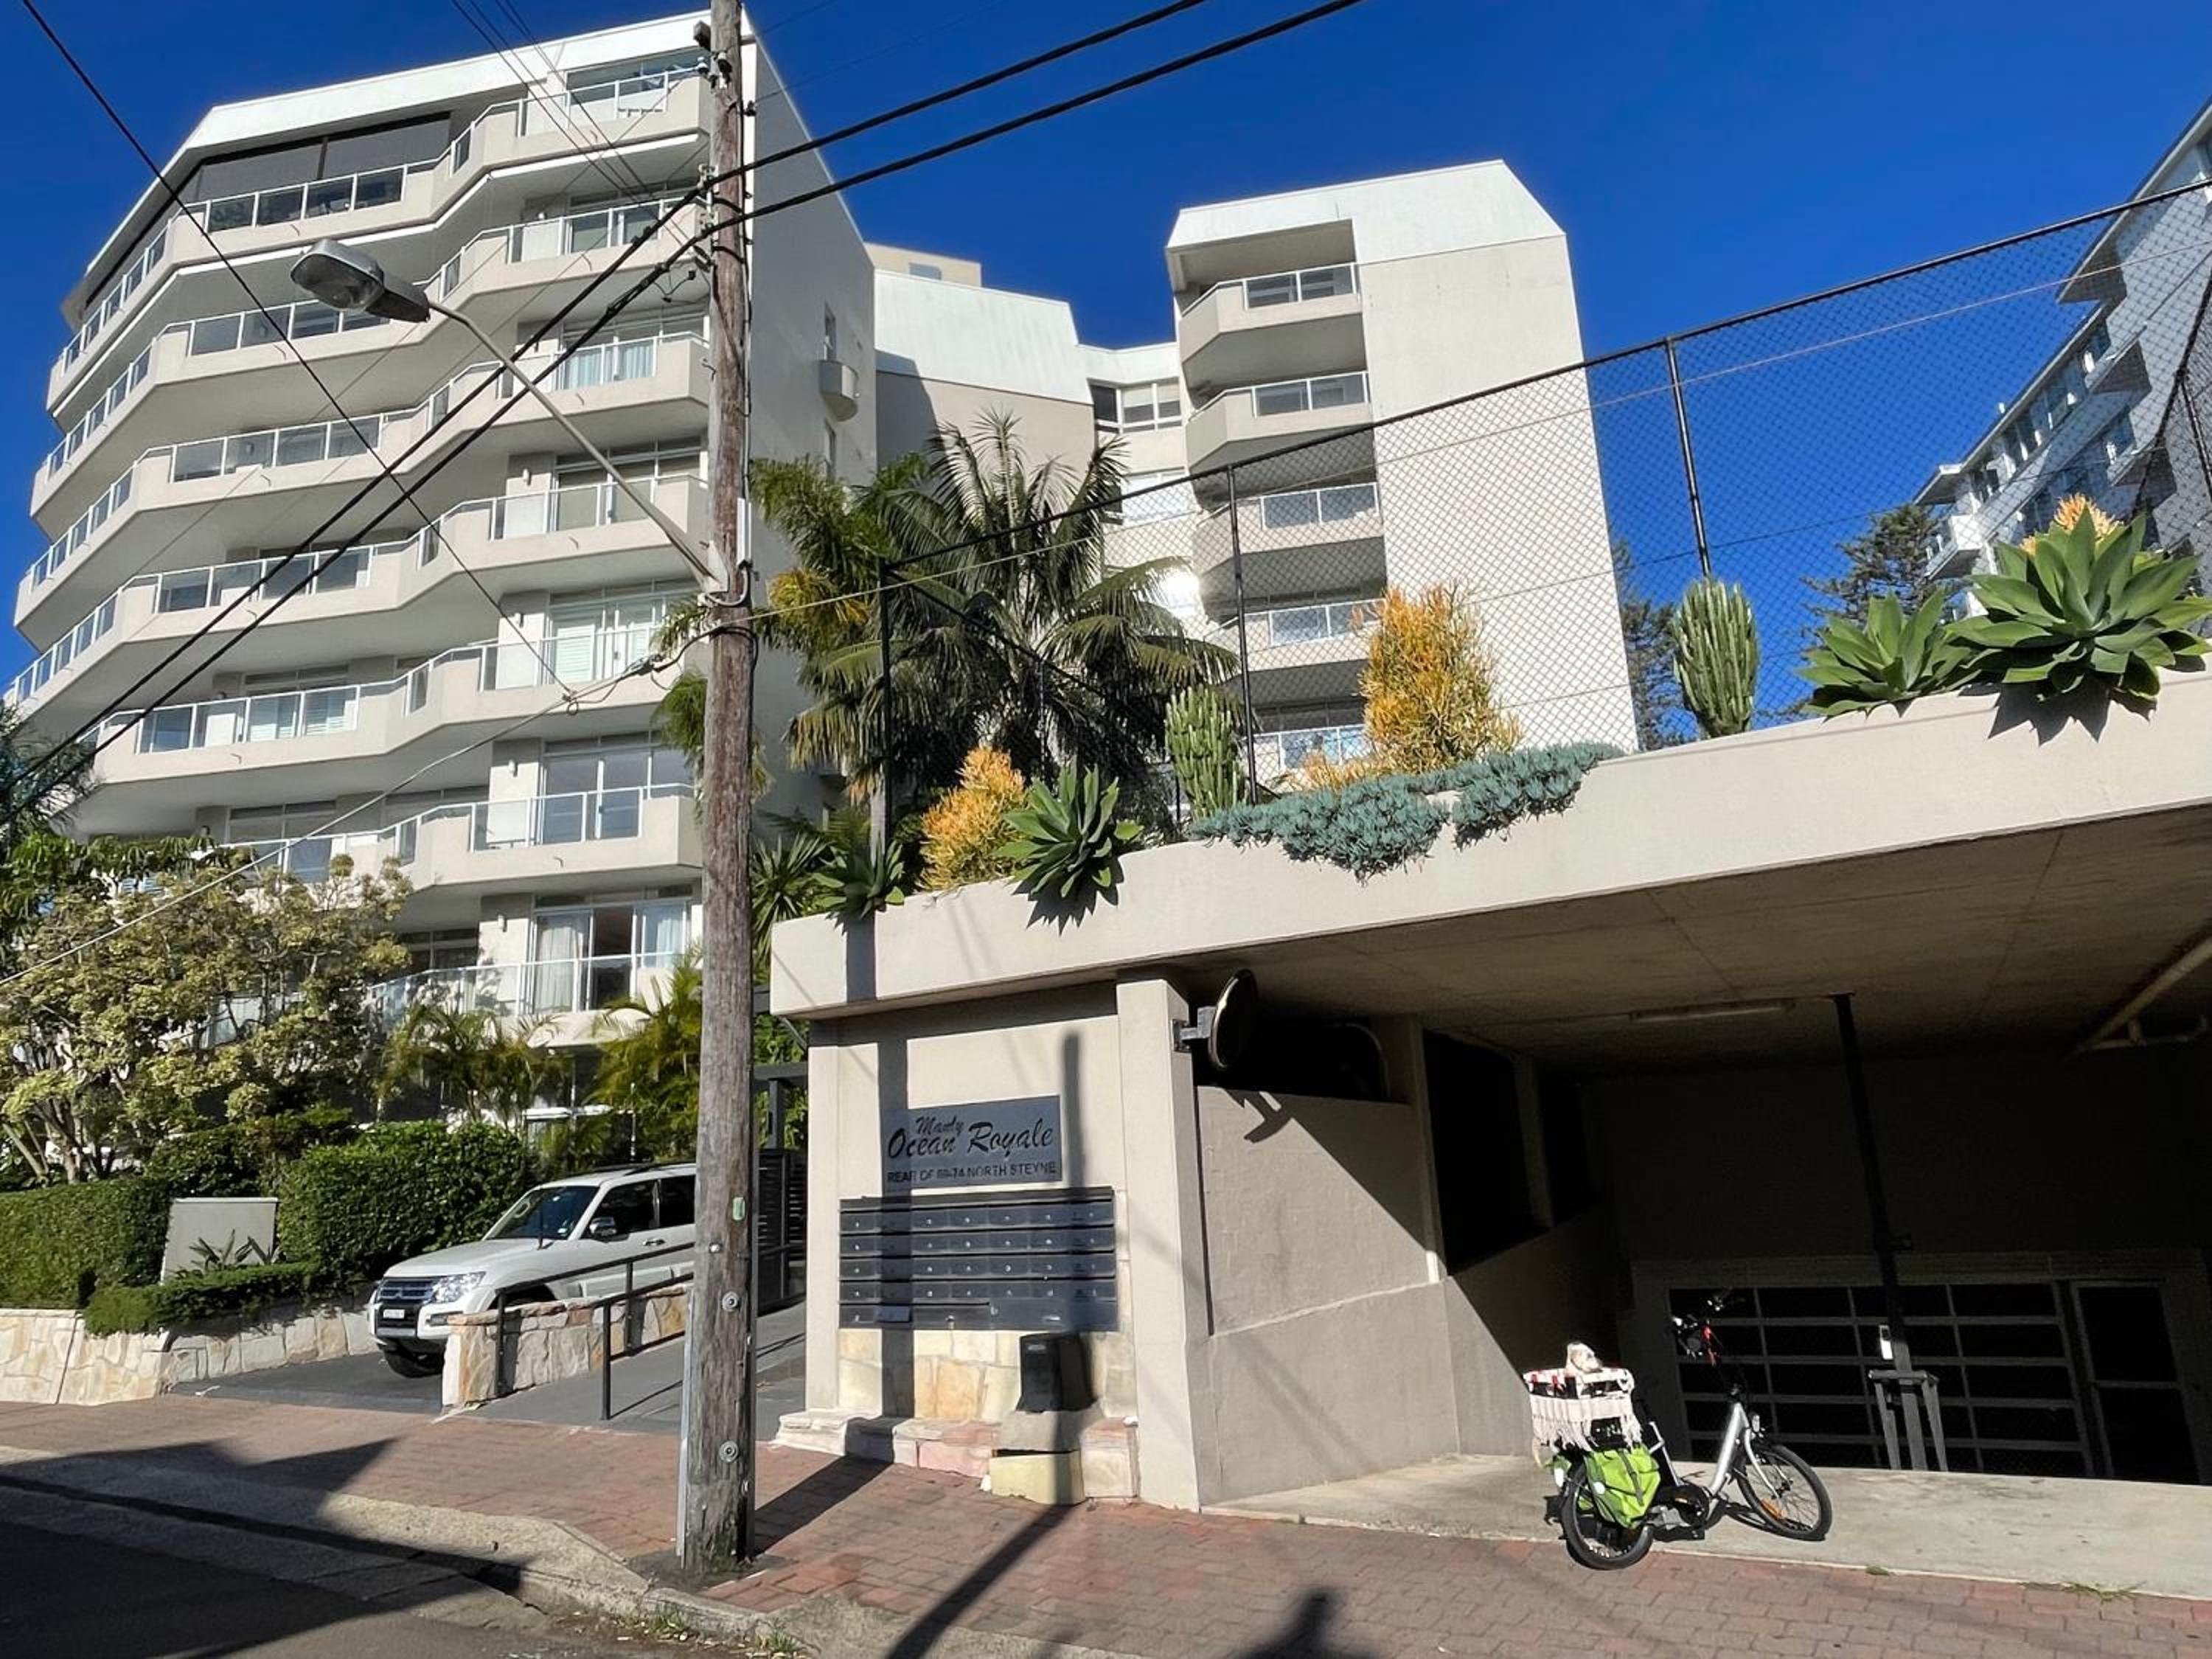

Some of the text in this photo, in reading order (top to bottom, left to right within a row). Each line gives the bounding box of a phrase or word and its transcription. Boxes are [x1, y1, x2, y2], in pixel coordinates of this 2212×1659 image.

[888, 1118, 1054, 1158] Ocean Royale
[887, 1169, 917, 1183] REAR
[919, 1167, 934, 1180] OF
[967, 1164, 1006, 1178] NORTH
[1010, 1161, 1057, 1176] STEYNE
